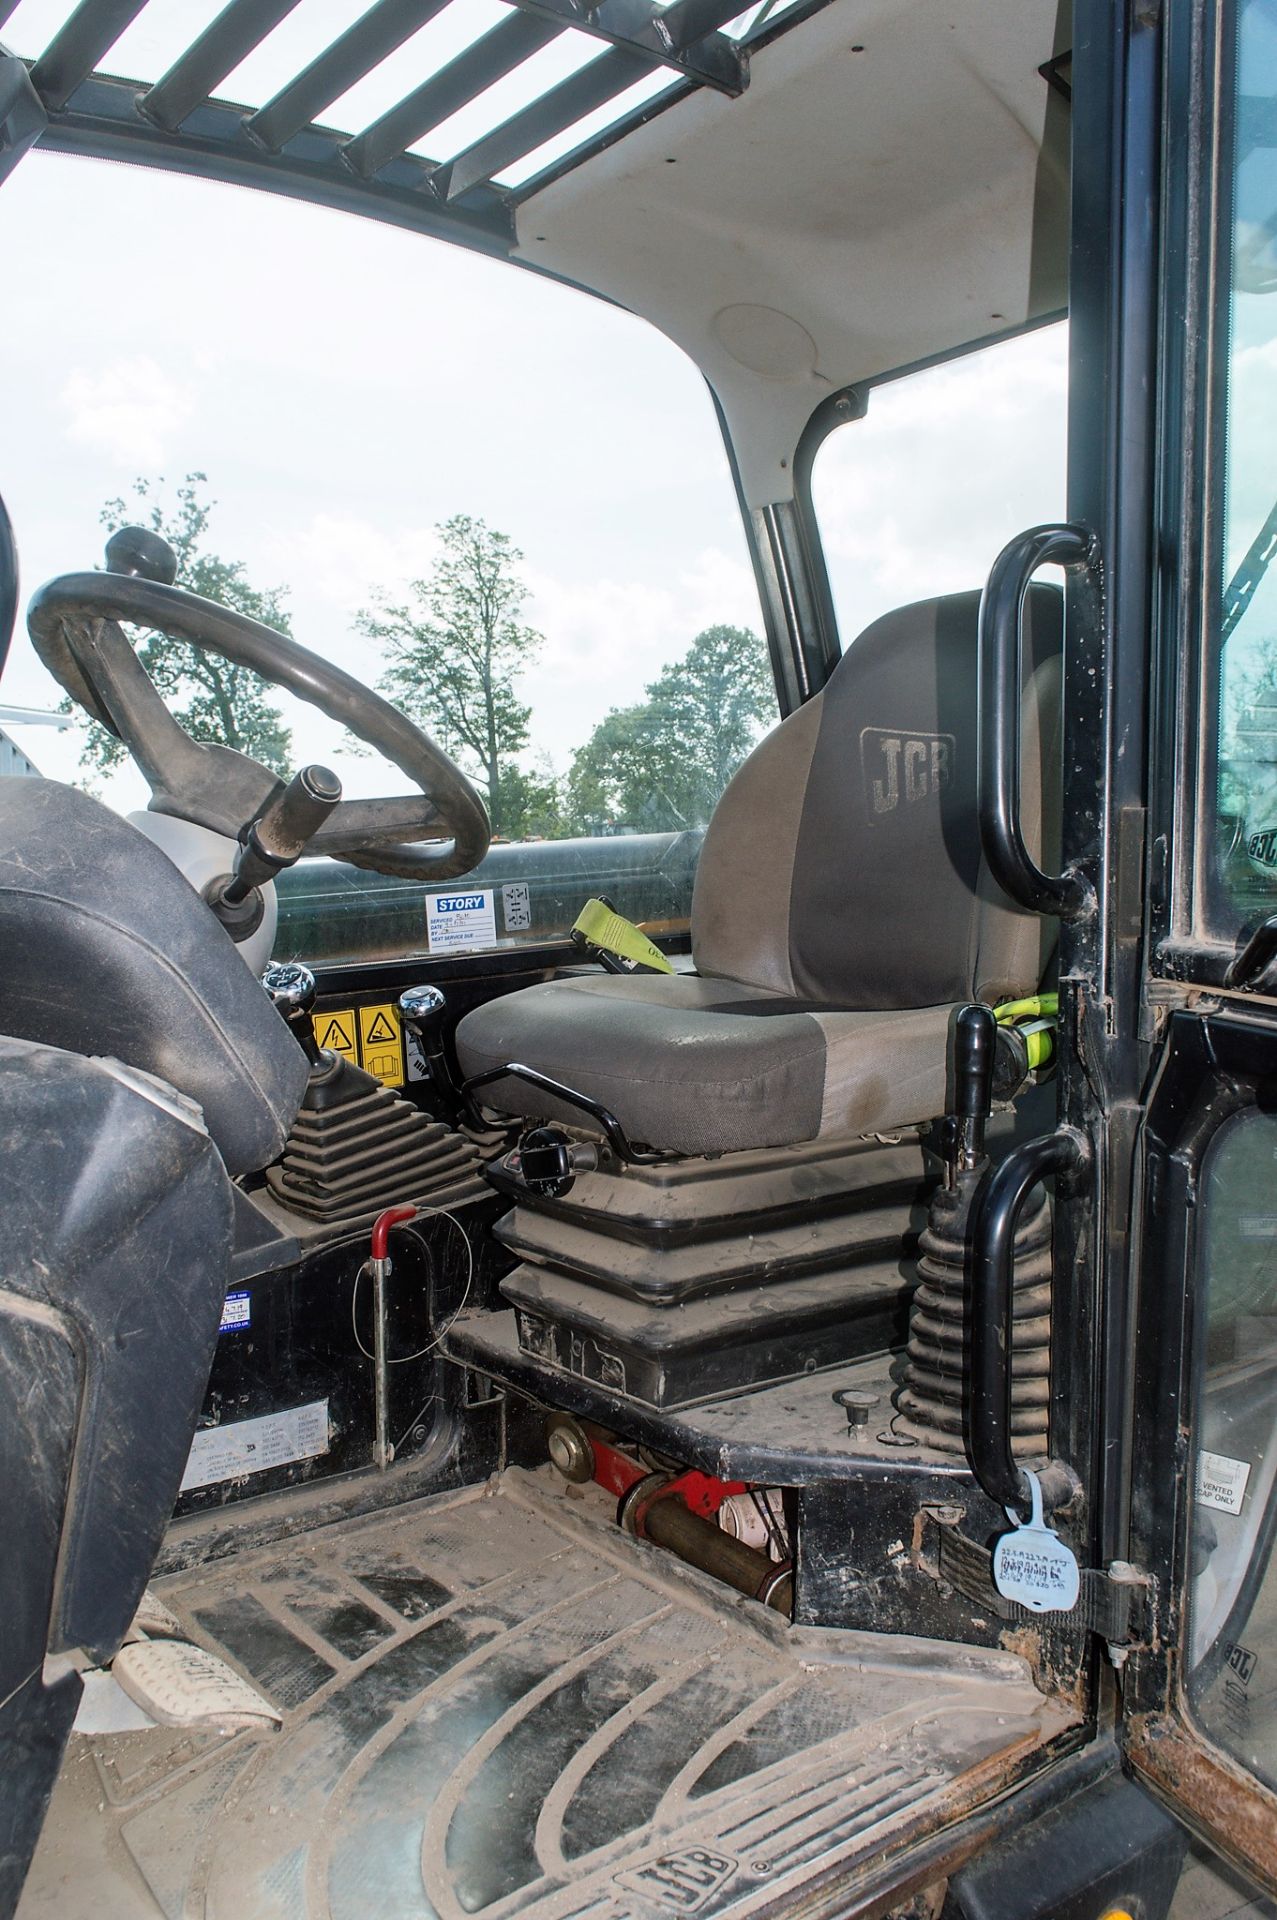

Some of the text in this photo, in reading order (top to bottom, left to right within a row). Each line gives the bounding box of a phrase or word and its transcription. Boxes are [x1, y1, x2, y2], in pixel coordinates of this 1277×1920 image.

[872, 738, 949, 814] JCB
[439, 895, 483, 911] STORY
[1198, 1488, 1235, 1506] CAP ONLY
[1203, 1481, 1233, 1496] VENTED
[637, 1849, 729, 1905] JCB
